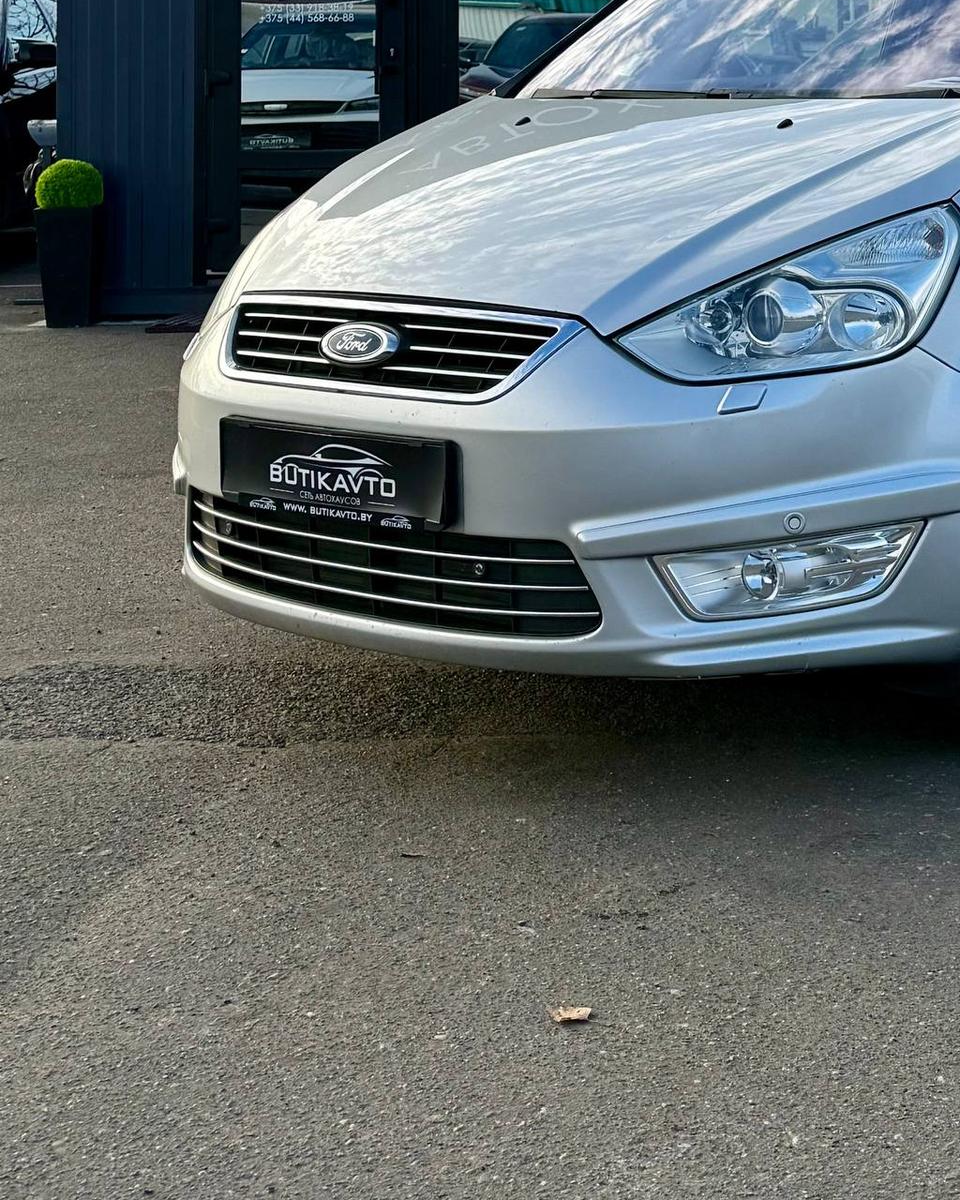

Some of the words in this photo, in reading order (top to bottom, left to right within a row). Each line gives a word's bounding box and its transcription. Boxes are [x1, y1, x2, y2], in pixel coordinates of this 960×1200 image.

[286, 13, 304, 24] (44)
[307, 13, 354, 22] 568-66-88
[336, 332, 372, 351] Ford
[270, 464, 396, 498] BUTIKAVTO
[300, 490, 314, 499] СЕТЬ
[315, 493, 361, 506] АВТОХАУСОВ
[283, 502, 307, 513] WWW.
[310, 506, 372, 522] BUTIKAVTO.BY
